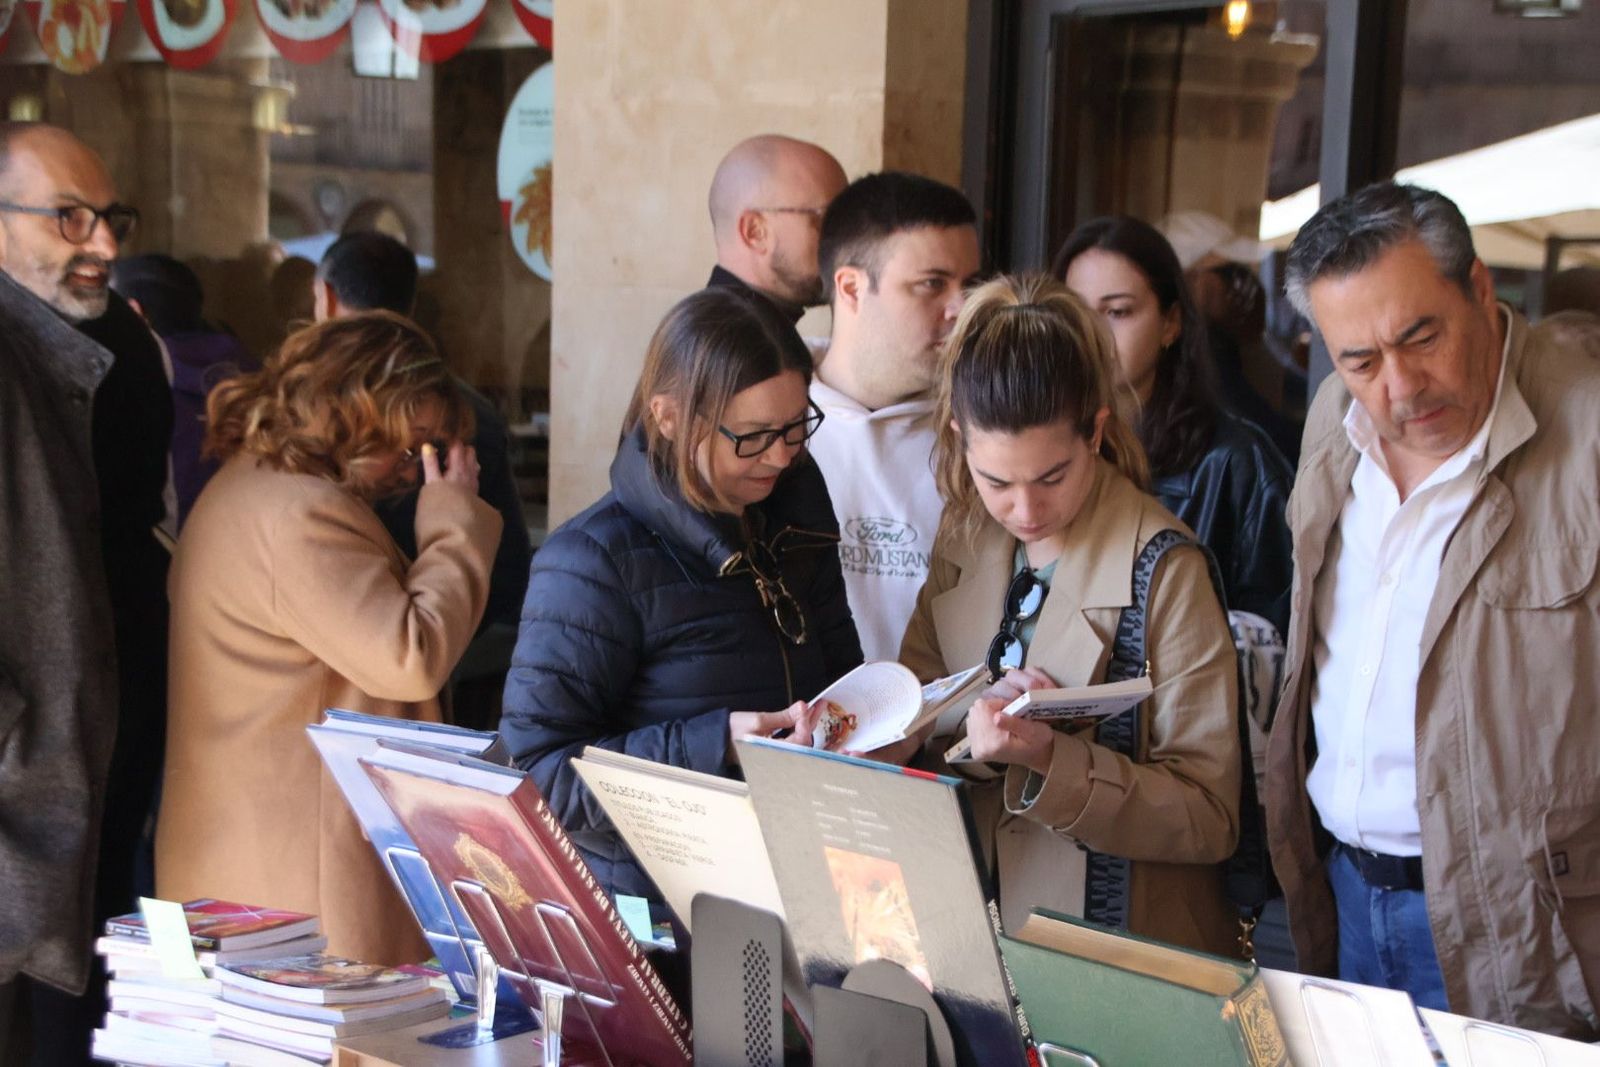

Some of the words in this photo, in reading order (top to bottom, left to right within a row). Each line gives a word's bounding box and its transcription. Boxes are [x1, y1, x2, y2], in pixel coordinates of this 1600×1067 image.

[856, 521, 905, 544] Ford
[864, 547, 929, 569] MUSTAN
[536, 798, 596, 890] SALAMANCA
[592, 886, 611, 912] DE
[609, 907, 641, 959] NUEVA
